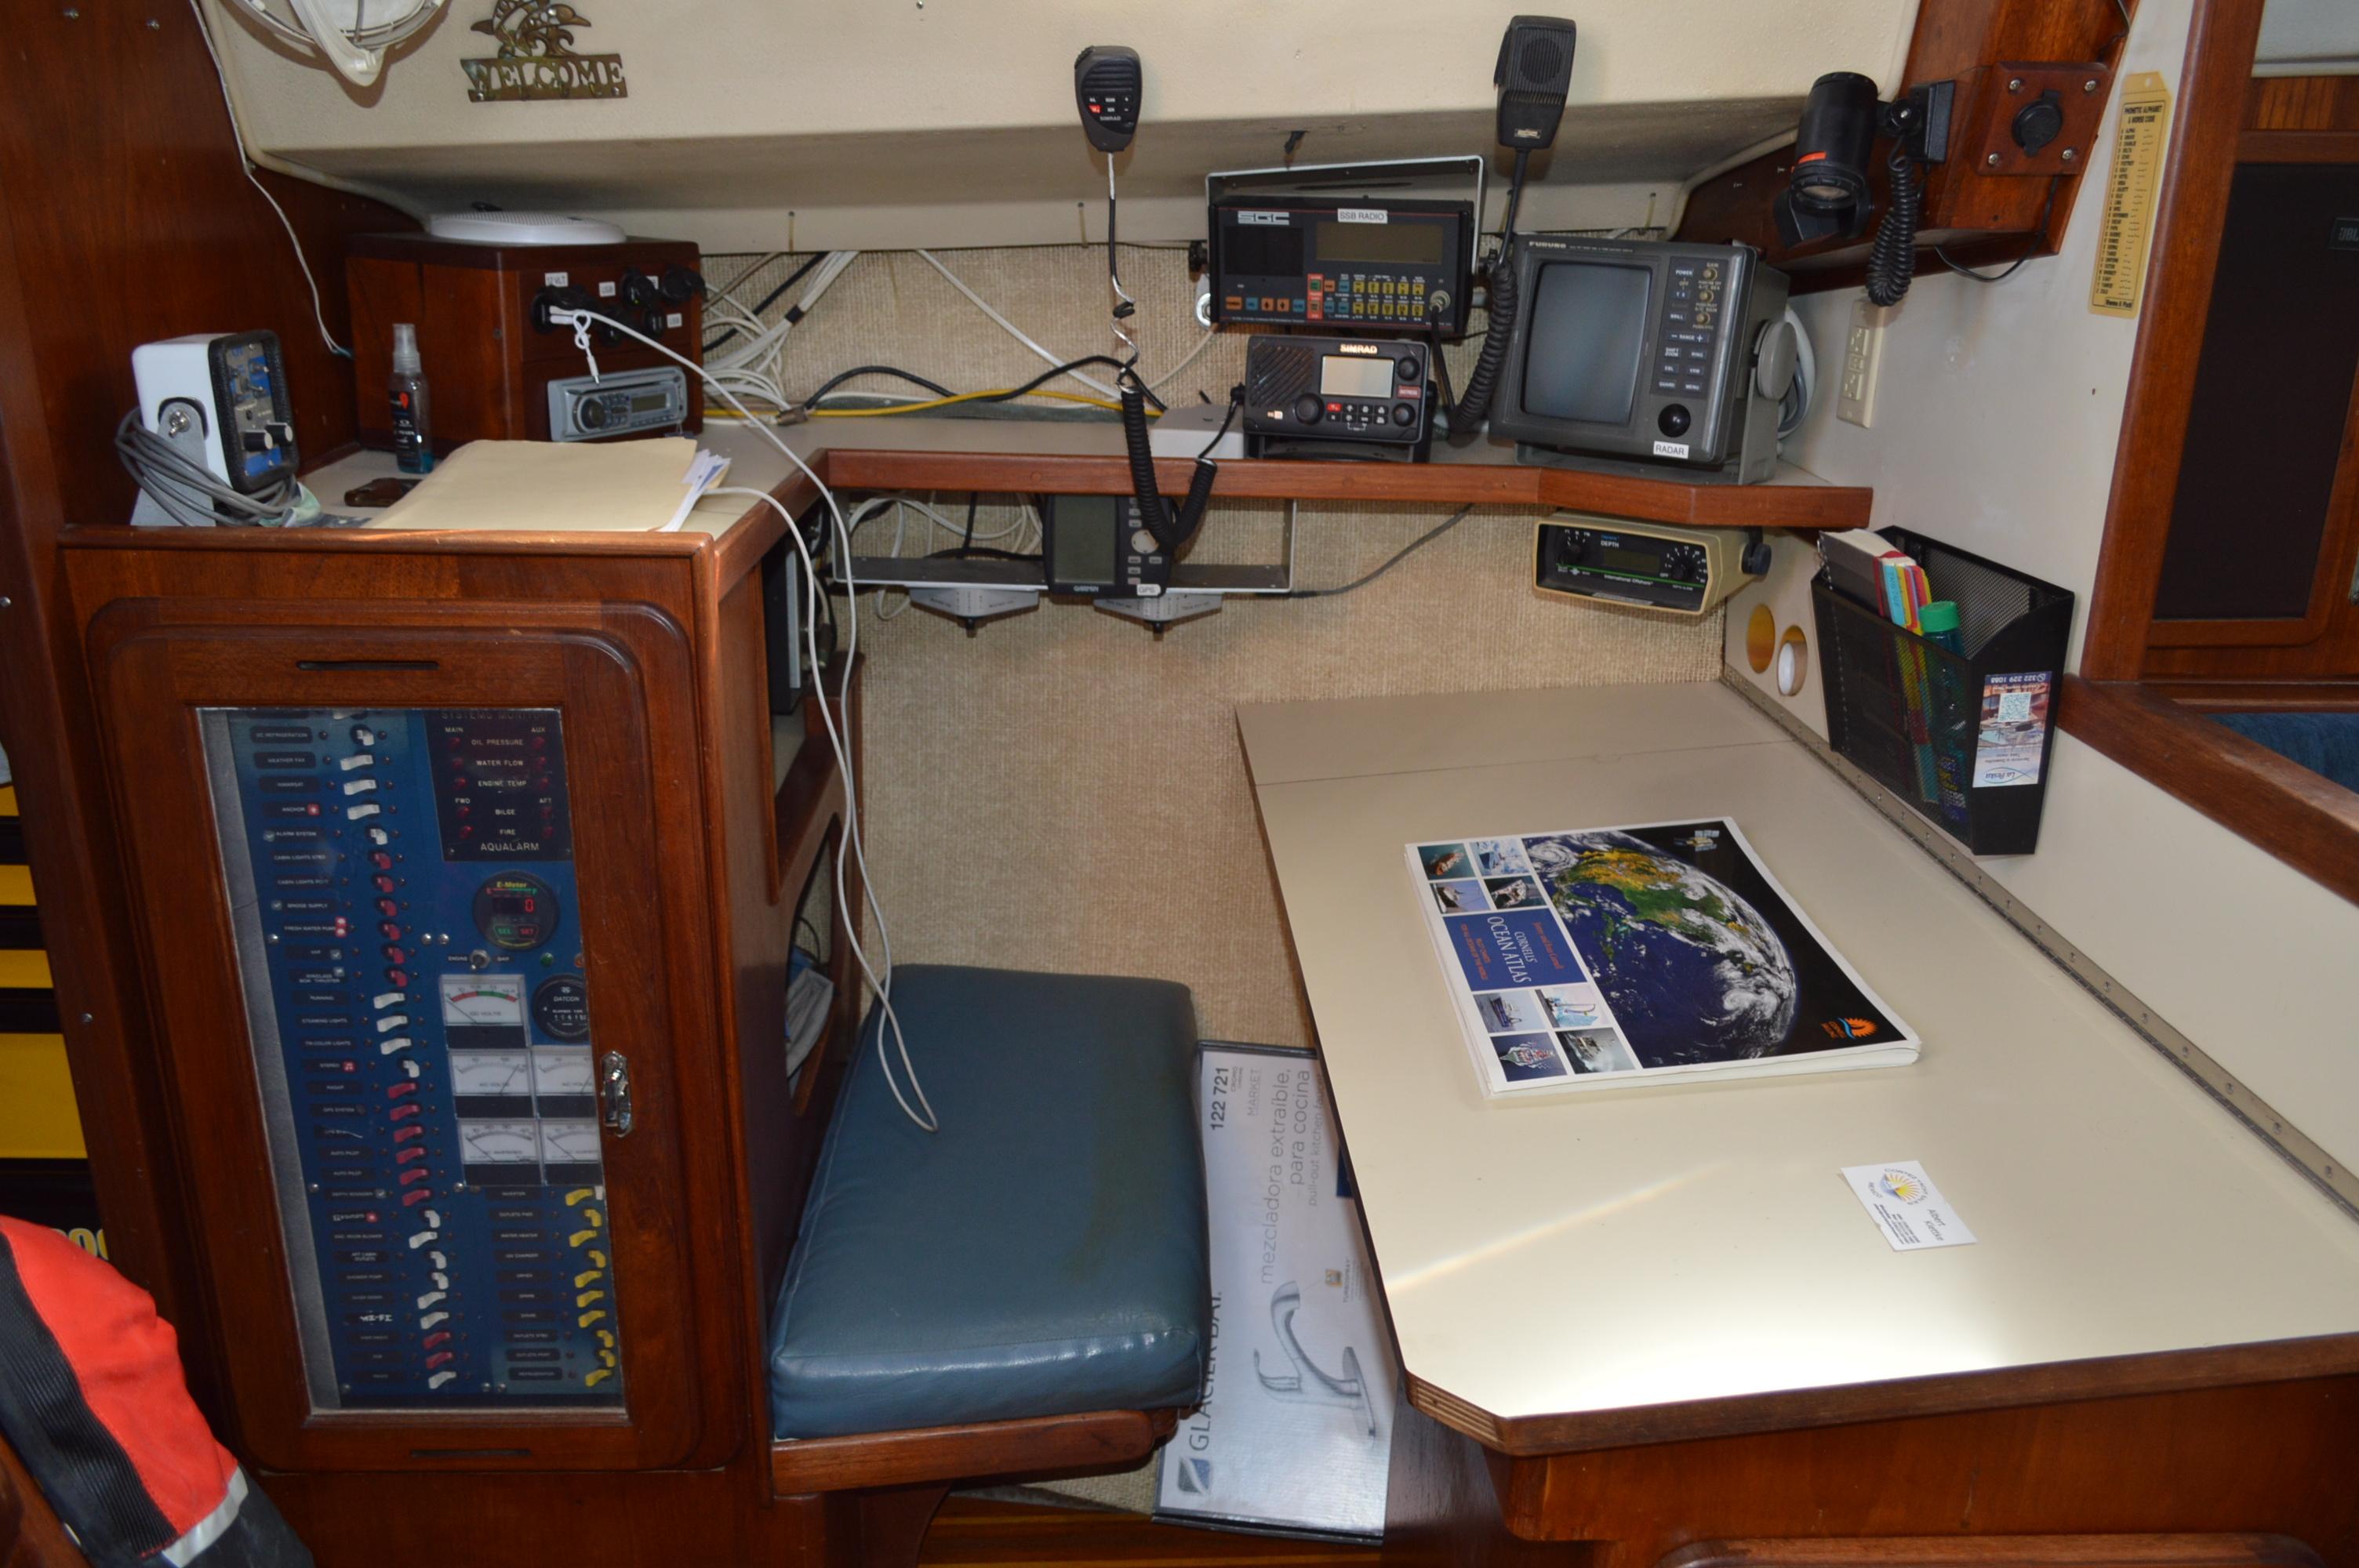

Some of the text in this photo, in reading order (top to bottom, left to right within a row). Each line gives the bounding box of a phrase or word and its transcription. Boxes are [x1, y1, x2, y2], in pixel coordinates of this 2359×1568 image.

[467, 60, 624, 91] WELCOME
[1339, 211, 1385, 221] SSB RADIO
[1339, 343, 1378, 354] SIMRAD
[1655, 445, 1685, 455] RADAR
[1600, 539, 1619, 548] DEPTH
[480, 842, 540, 851] AQUALARM
[525, 898, 534, 913] 0
[1487, 916, 1532, 984] OCEAN ATLAS
[1210, 1067, 1229, 1131] 122 721
[1247, 1068, 1259, 1116] MARKET
[1290, 1069, 1310, 1186] para cocina
[1310, 1109, 1324, 1156] kitchen
[1261, 1068, 1292, 1285] mezcladora extraíble,
[1309, 1156, 1320, 1207] pull-out
[1927, 1208, 1946, 1227] Albert
